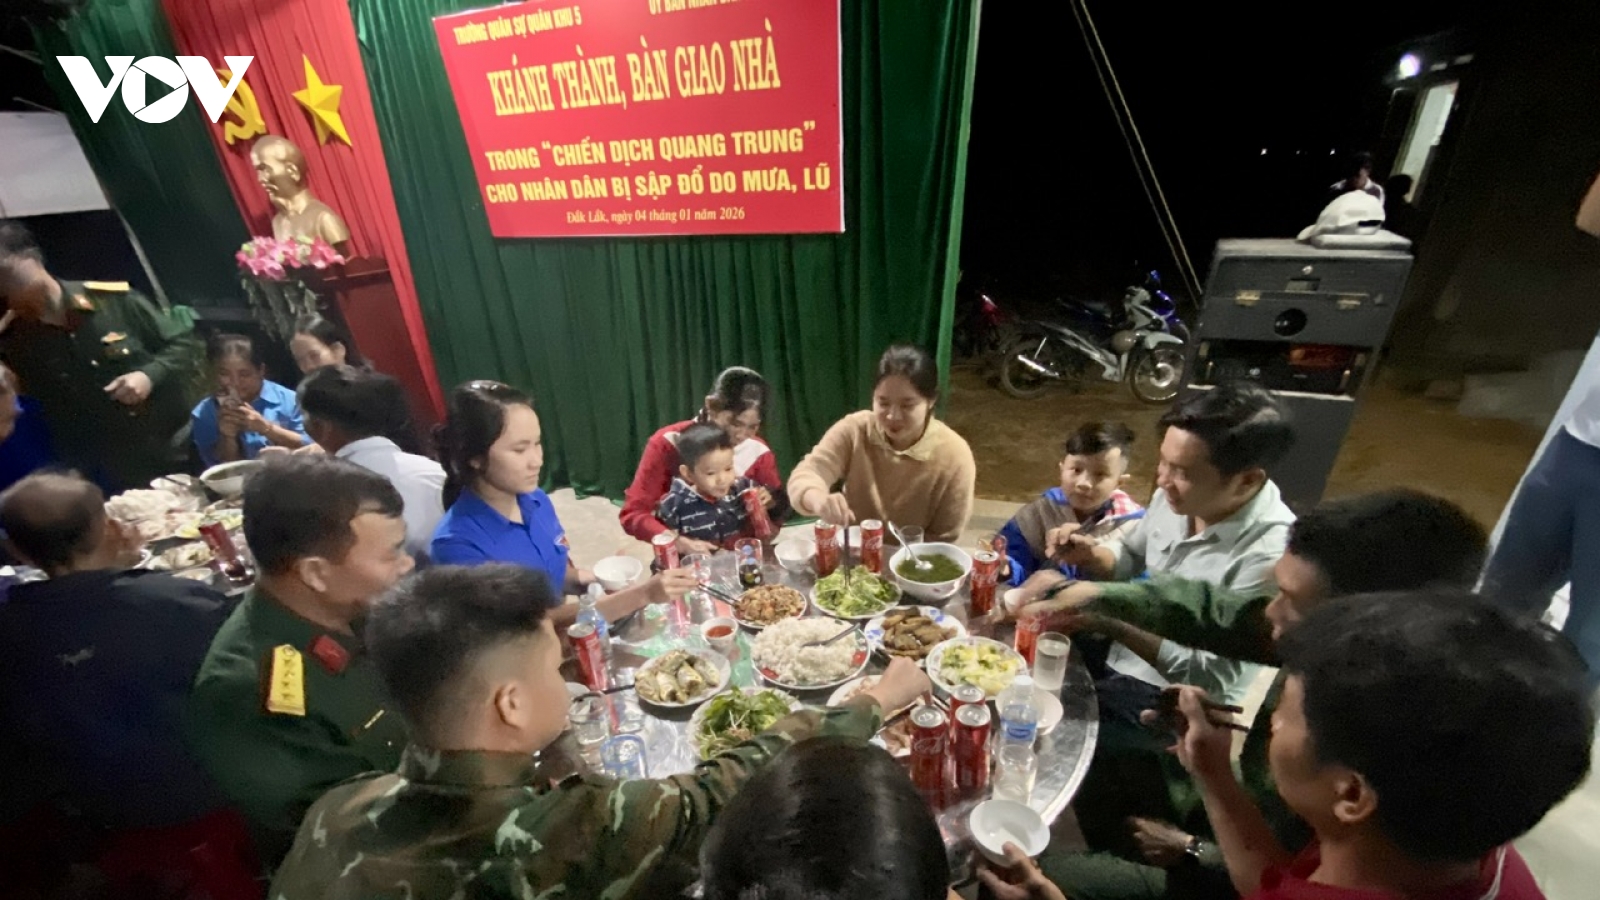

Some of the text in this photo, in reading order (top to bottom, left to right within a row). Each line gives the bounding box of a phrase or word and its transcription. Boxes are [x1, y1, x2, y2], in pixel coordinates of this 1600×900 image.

[573, 5, 582, 25] 5
[486, 17, 781, 116] KHÁNH THÀNH, BÀN GIAO NHÀ
[485, 147, 541, 171] TRONG
[609, 138, 655, 167] DỊCH
[659, 133, 727, 162] QUANG
[485, 162, 831, 203] CHO NHÂN DÂN BỊ SẬP ĐỔ DO MƯA, LŨ
[611, 210, 633, 225] ngày
[634, 209, 647, 222] 04
[679, 208, 691, 221] 01
[719, 206, 745, 220] 2026
